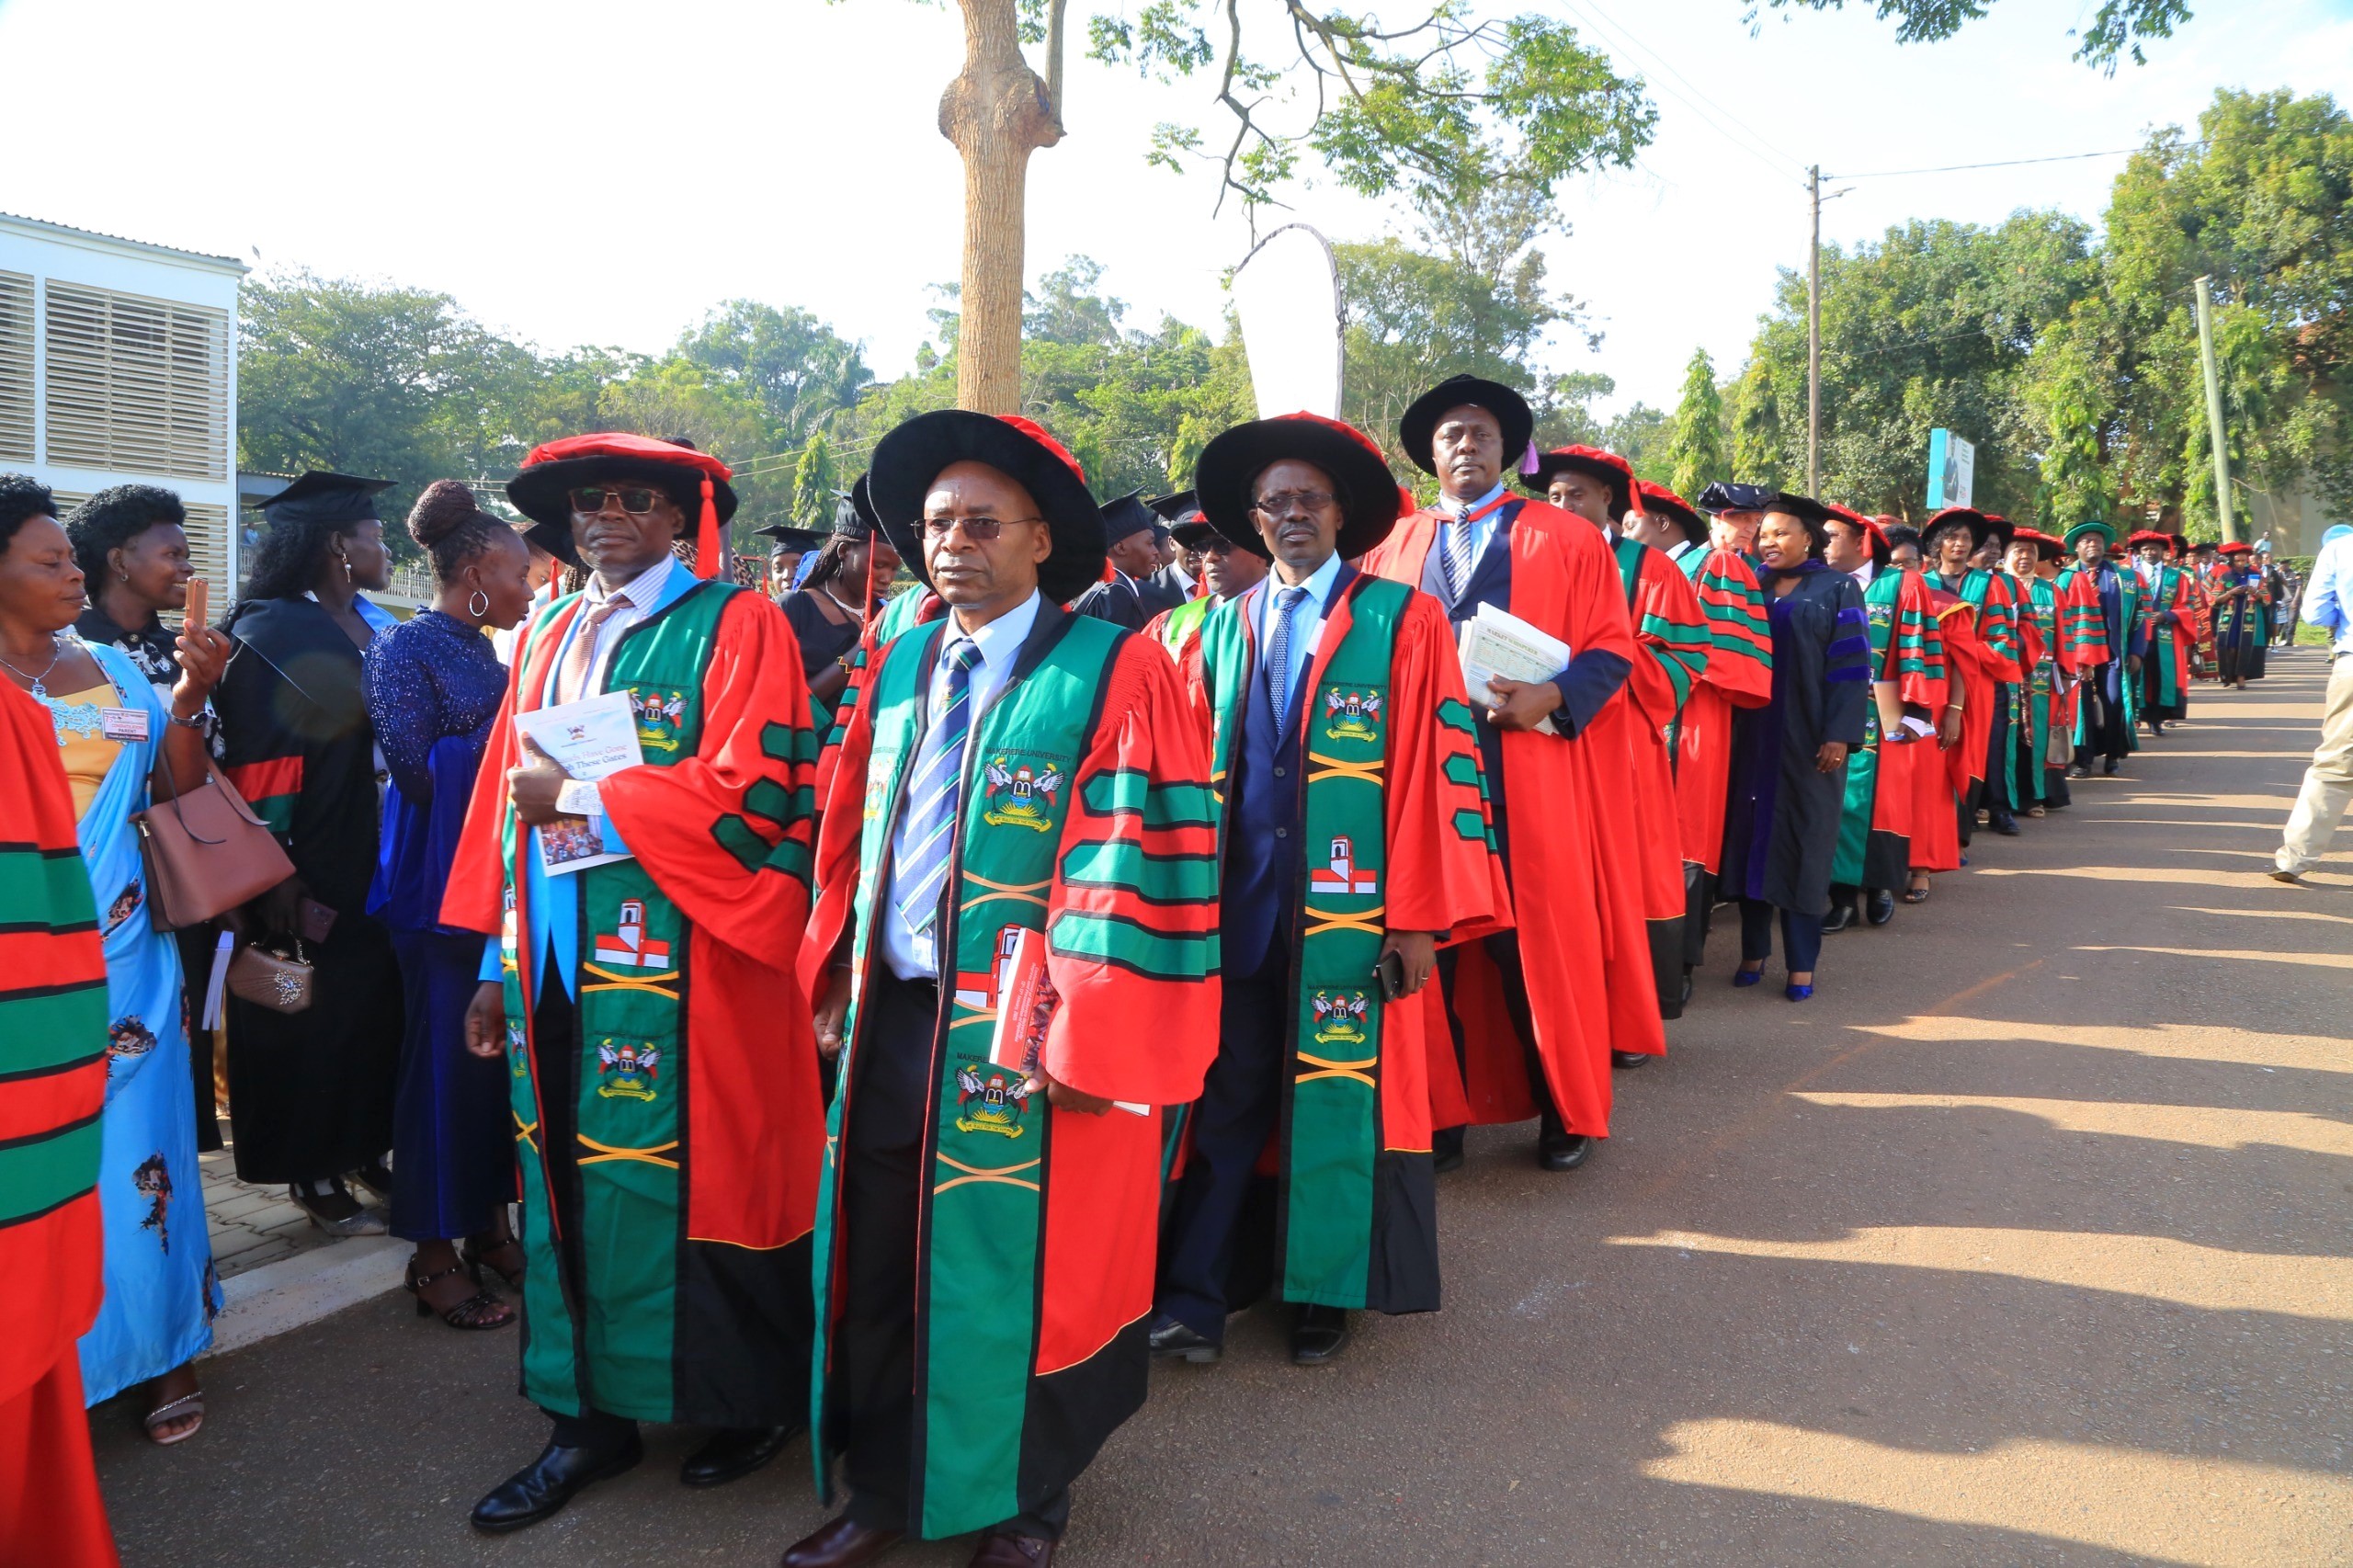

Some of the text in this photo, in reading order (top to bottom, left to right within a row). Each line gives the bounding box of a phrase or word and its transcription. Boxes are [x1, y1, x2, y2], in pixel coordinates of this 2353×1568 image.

[985, 747, 1071, 763] MAKERERE UNIVERSITY
[957, 1052, 990, 1062] MAKERE
